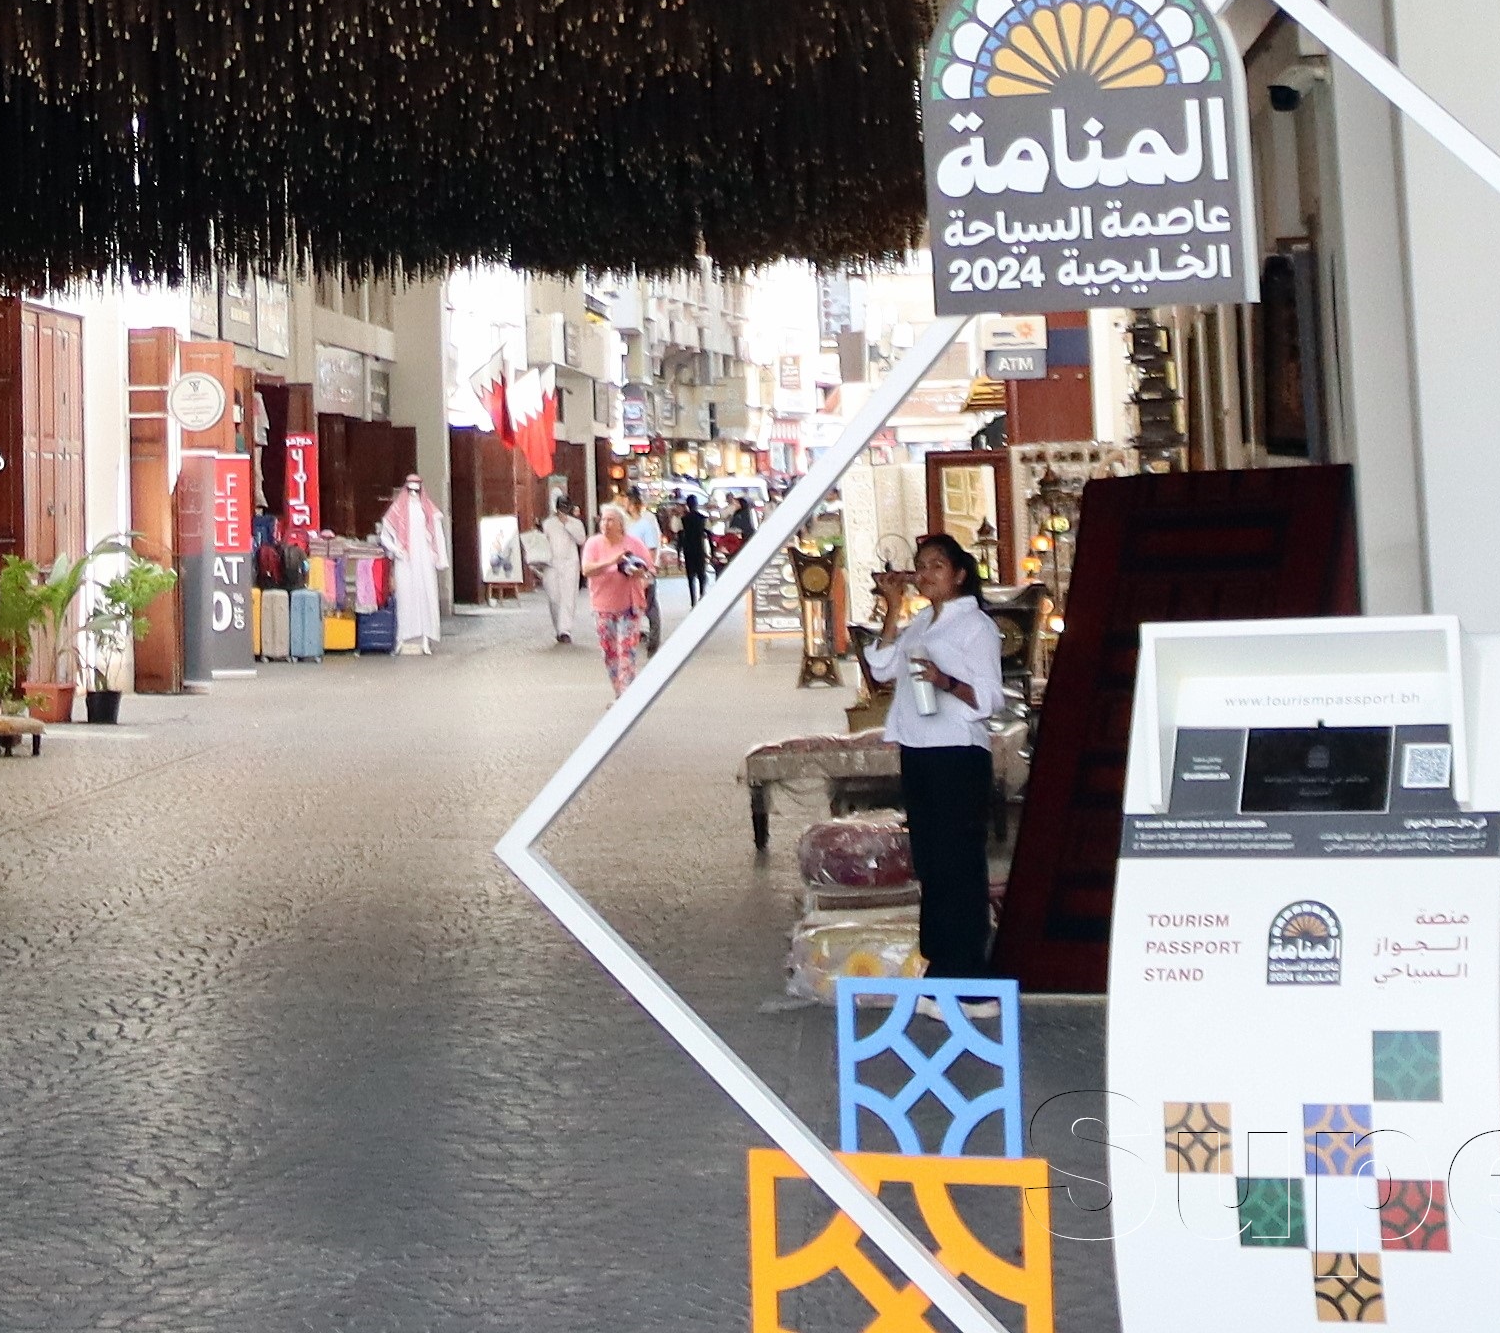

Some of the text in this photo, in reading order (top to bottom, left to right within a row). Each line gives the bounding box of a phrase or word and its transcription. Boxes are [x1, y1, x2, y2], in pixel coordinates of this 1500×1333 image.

[936, 96, 1230, 198] المنامة
[944, 199, 1231, 255] عاصمة السياحة
[949, 243, 1232, 296] الخليجية 2024
[998, 357, 1034, 372] ATM
[1224, 693, 1421, 707] www.tourismpassport.bh
[1147, 914, 1231, 928] TOURISM
[1415, 908, 1471, 925] منصة
[1146, 941, 1242, 955] PASSPORT
[1269, 938, 1341, 960] المنامة
[1143, 968, 1204, 982] STAND
